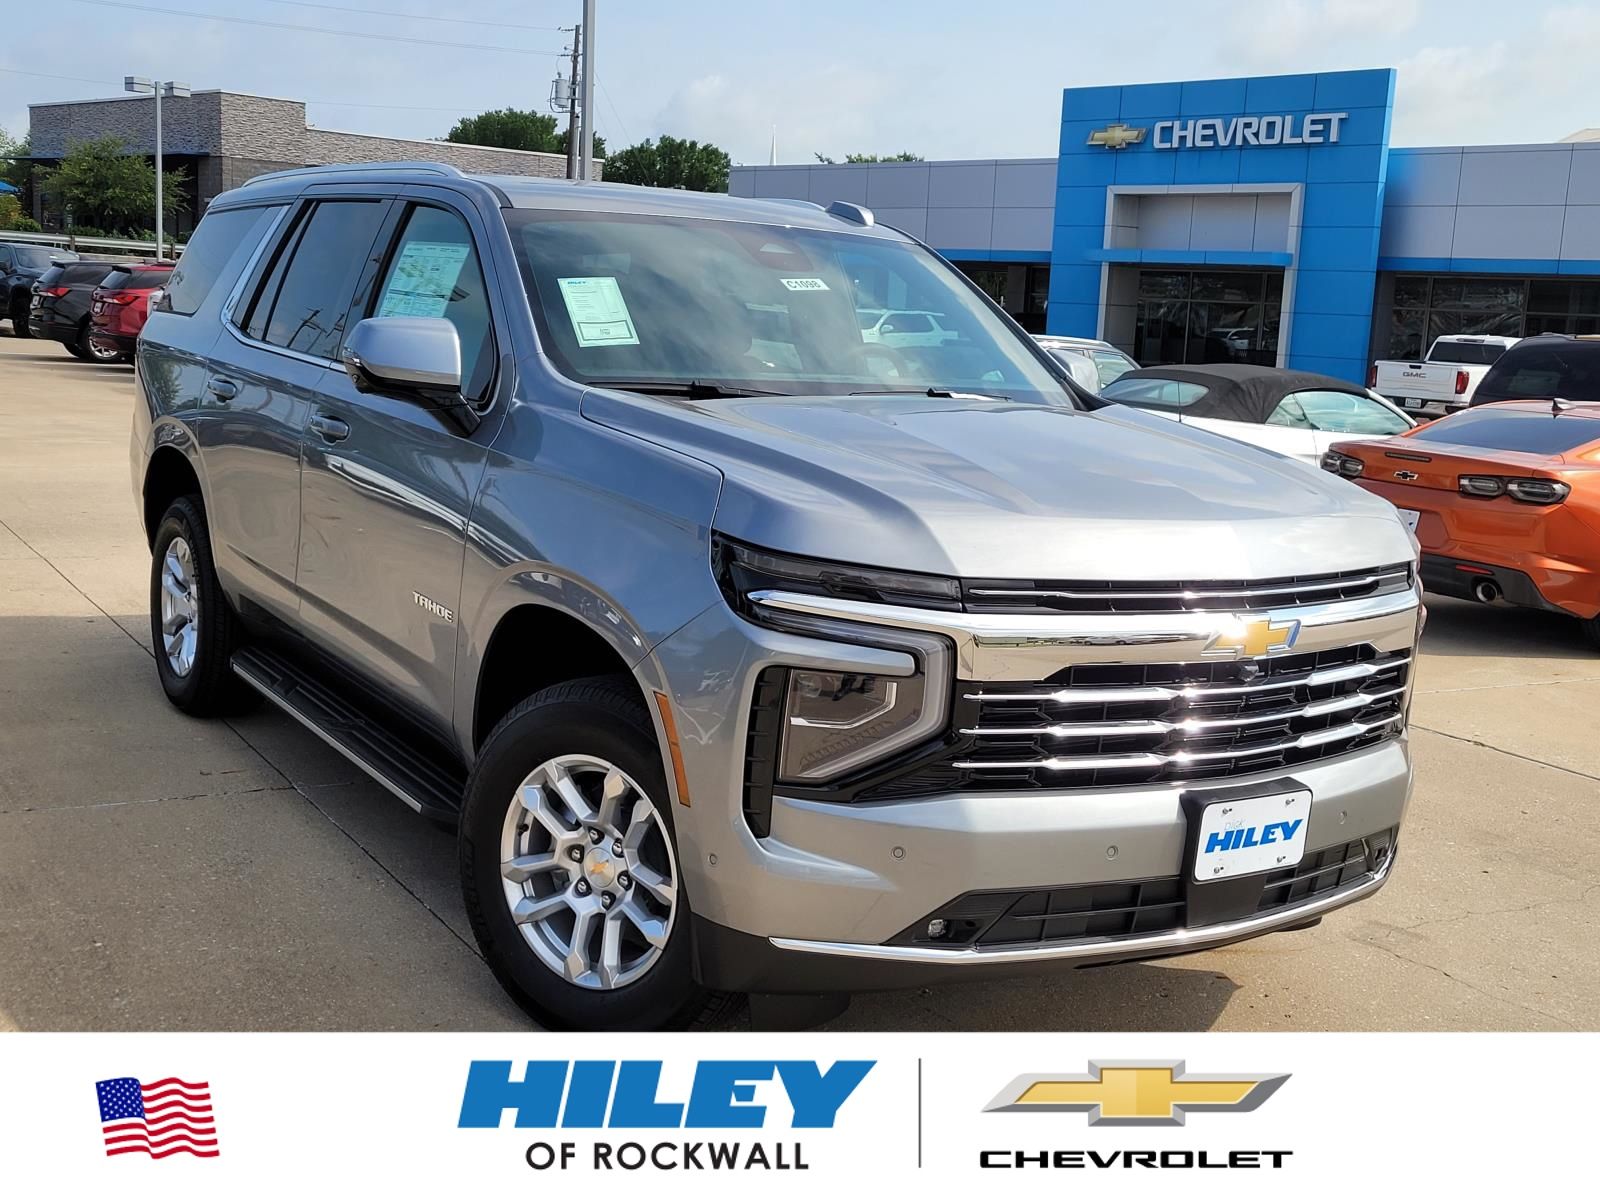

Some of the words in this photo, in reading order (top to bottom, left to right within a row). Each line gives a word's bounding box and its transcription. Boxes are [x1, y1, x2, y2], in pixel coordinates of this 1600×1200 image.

[1153, 112, 1348, 149] CHEVROLET
[412, 591, 454, 623] TAHOE
[1204, 819, 1302, 853] HILEY
